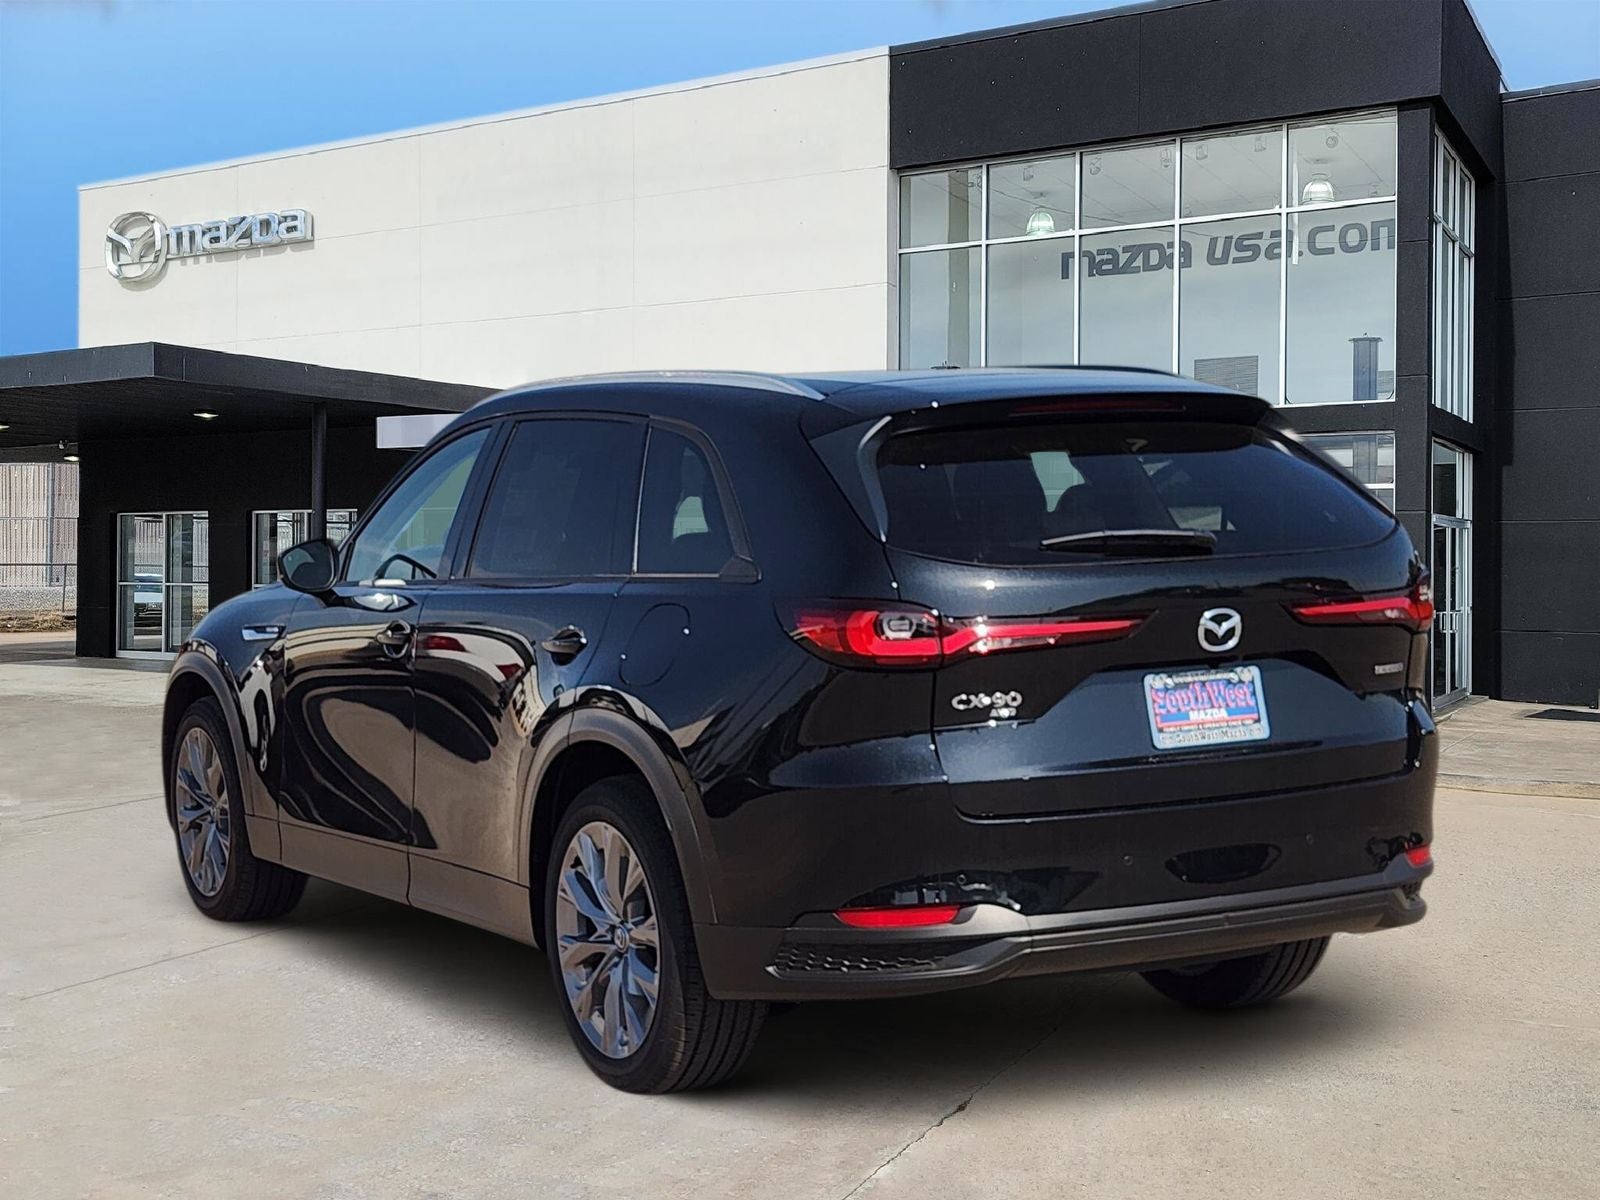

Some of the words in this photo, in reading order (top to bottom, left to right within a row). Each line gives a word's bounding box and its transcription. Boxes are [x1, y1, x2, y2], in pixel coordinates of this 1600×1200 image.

[166, 208, 313, 256] mazda
[1061, 240, 1193, 280] mazda
[951, 690, 1023, 711] CX90
[989, 707, 1018, 719] AD
[1188, 707, 1229, 722] MAZDA
